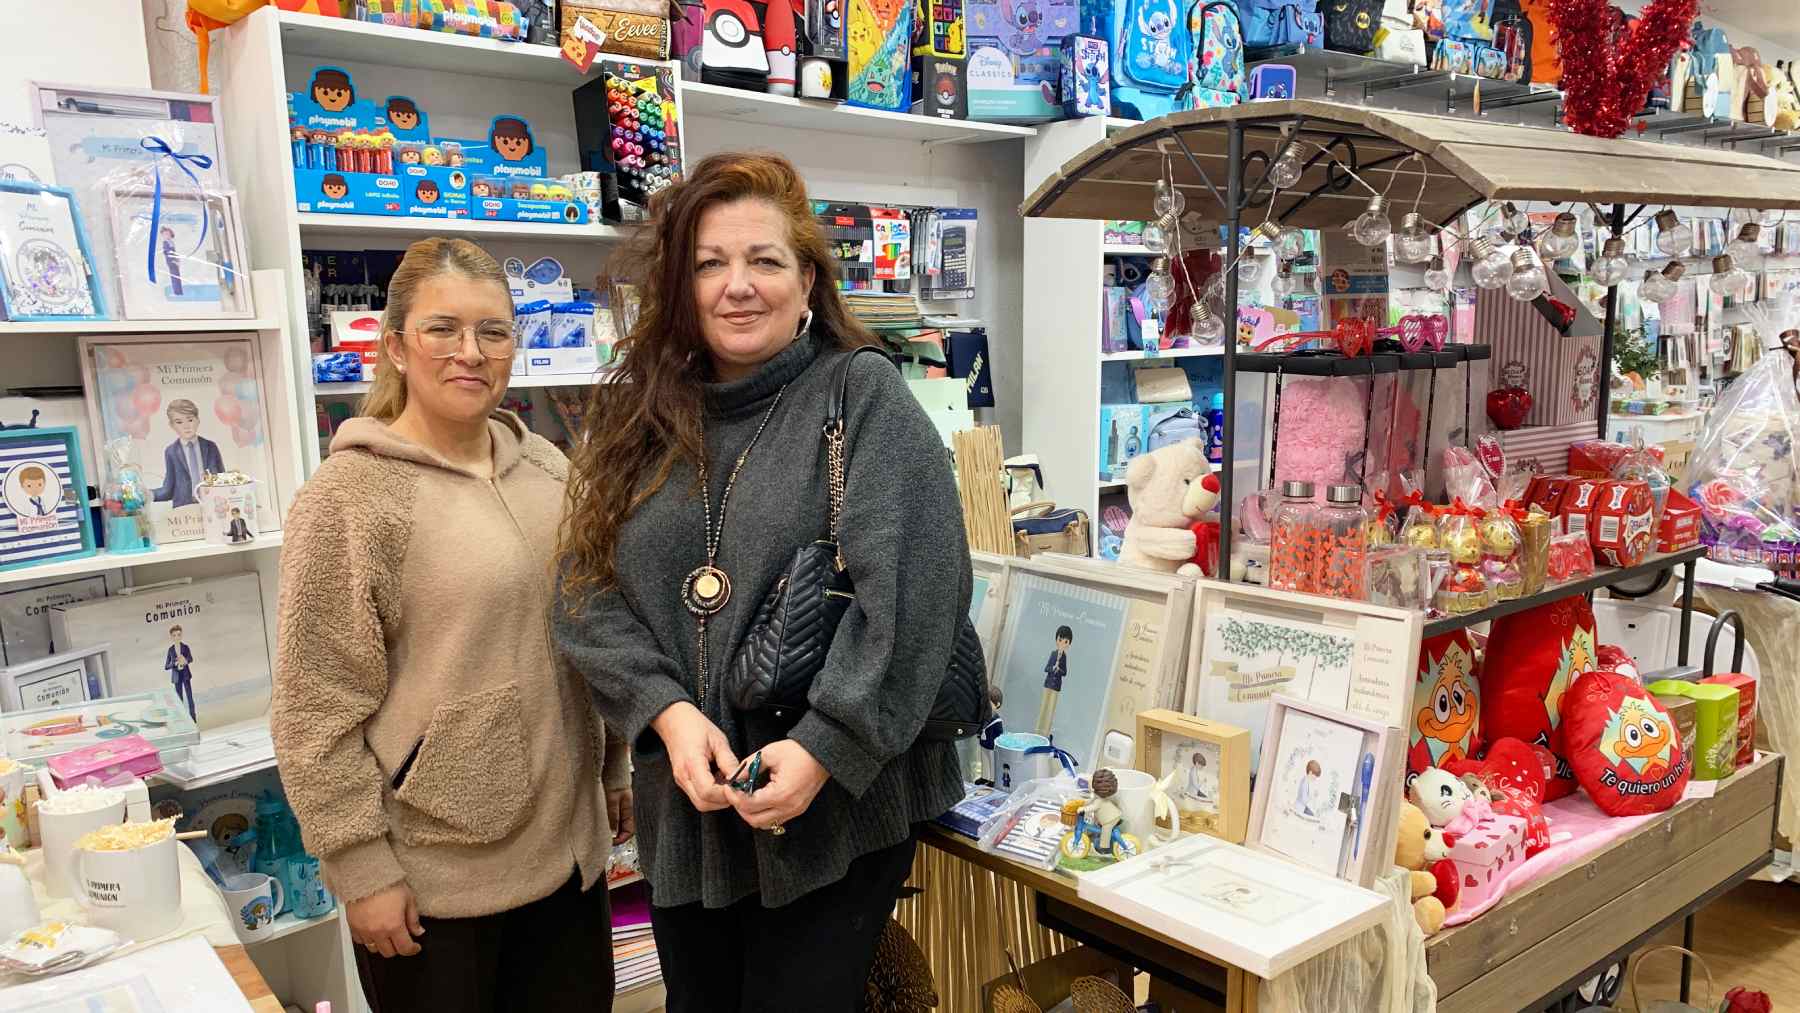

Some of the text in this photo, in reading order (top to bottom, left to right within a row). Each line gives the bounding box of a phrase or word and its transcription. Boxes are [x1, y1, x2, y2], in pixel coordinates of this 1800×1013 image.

[614, 18, 658, 42] Eevee
[308, 115, 357, 128] playmobil
[493, 163, 541, 177] playmobil
[157, 364, 172, 374] Mi
[145, 604, 201, 623] Comunión
[1601, 768, 1617, 787] Te
[1618, 781, 1661, 795] quiero
[1662, 773, 1676, 788] un
